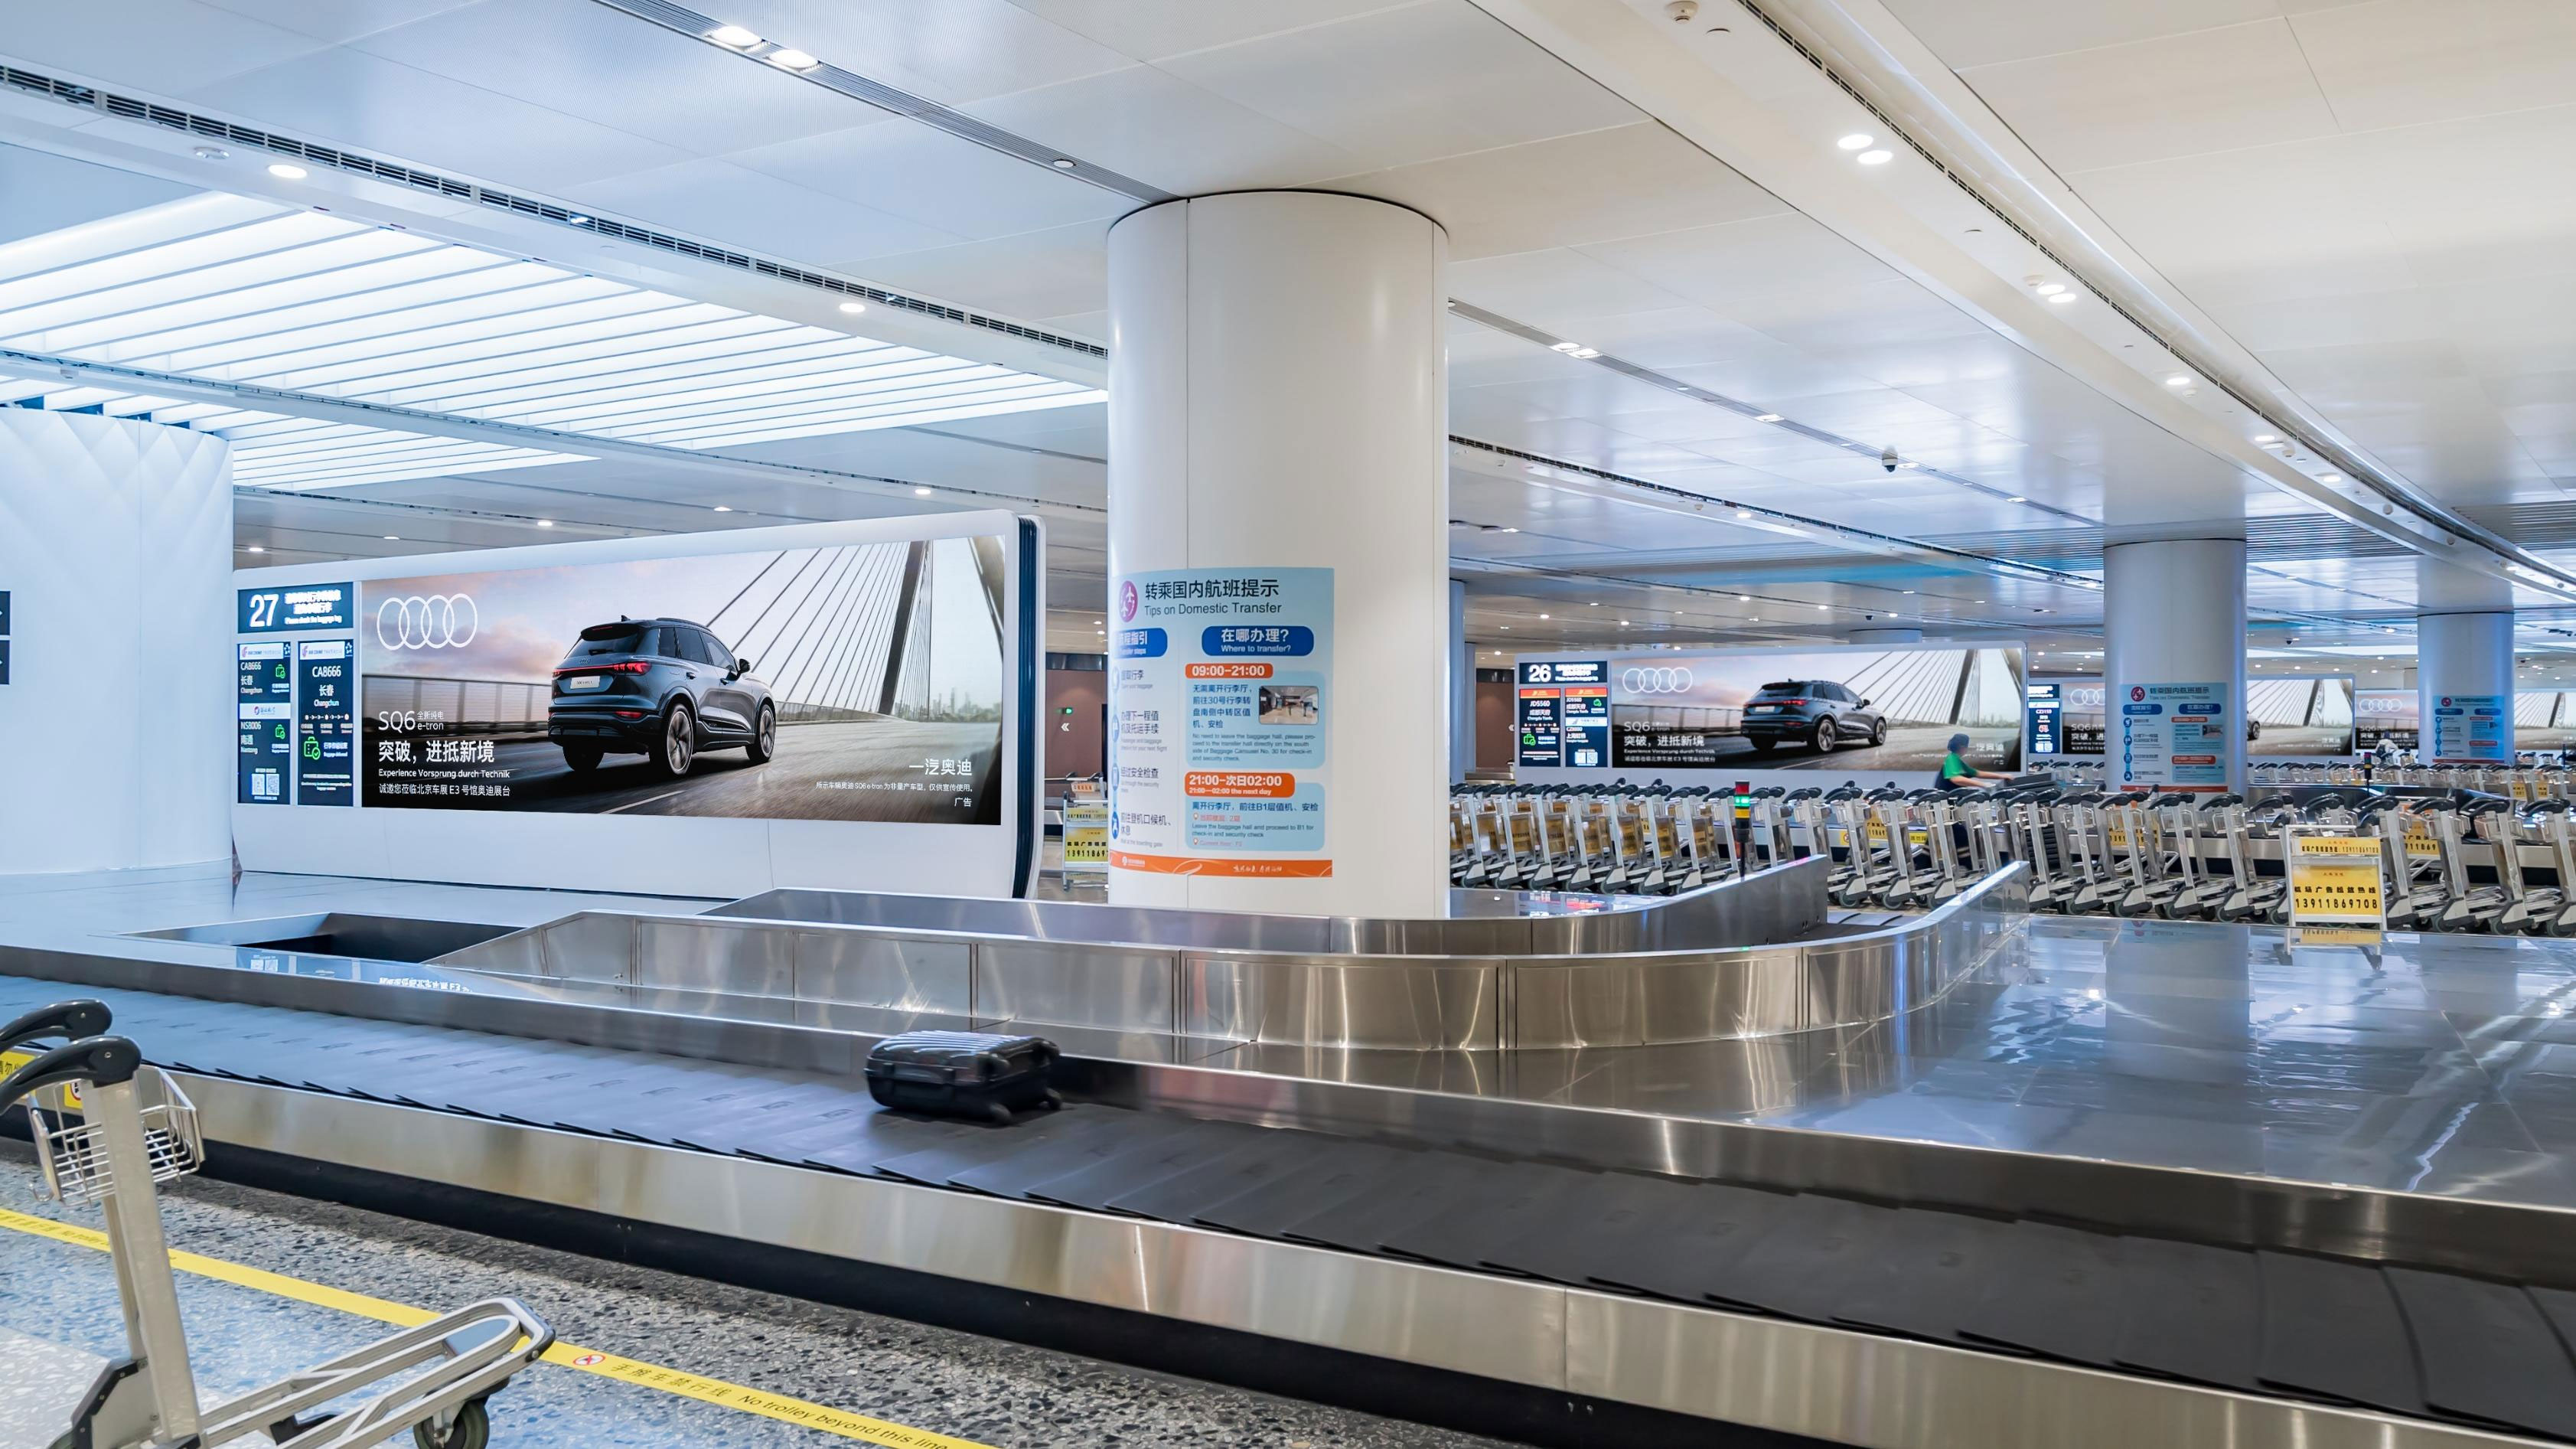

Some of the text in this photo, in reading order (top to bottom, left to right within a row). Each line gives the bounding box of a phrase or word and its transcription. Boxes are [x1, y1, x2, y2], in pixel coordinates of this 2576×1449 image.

[1146, 578, 1279, 600] 转乘国内航班提示
[249, 593, 279, 628] 27
[1144, 602, 1283, 618] Tips on Domestic Transfer
[311, 666, 341, 677] CA8666
[1528, 664, 1551, 682] 26
[240, 675, 253, 686] 长春
[319, 684, 334, 697] 长春
[1193, 696, 1251, 705] 前往30号行李转
[417, 711, 444, 720] 全新纯电
[1193, 708, 1251, 716] 盘南侧中转区值
[378, 710, 416, 733] SQ6
[417, 722, 444, 730] e-tron
[1193, 720, 1224, 728] 机、安检
[1624, 721, 1650, 733] SQ6
[2071, 723, 2091, 732] SQ6
[1624, 735, 1705, 747] 突破，进抵新境
[378, 740, 495, 764] 突破，进抵新境
[909, 758, 973, 776] 一汽奥迪
[378, 769, 510, 779] Experience Vorsprung durch Technik
[379, 783, 510, 796] 诚邀您莅临北京车展 E3 号馆奥迪展台
[954, 798, 972, 808] 广告
[2295, 898, 2378, 909] 13911869708
[611, 1363, 732, 1397] 手推车禁行线
[738, 1395, 948, 1449] No trolley beyond this line
